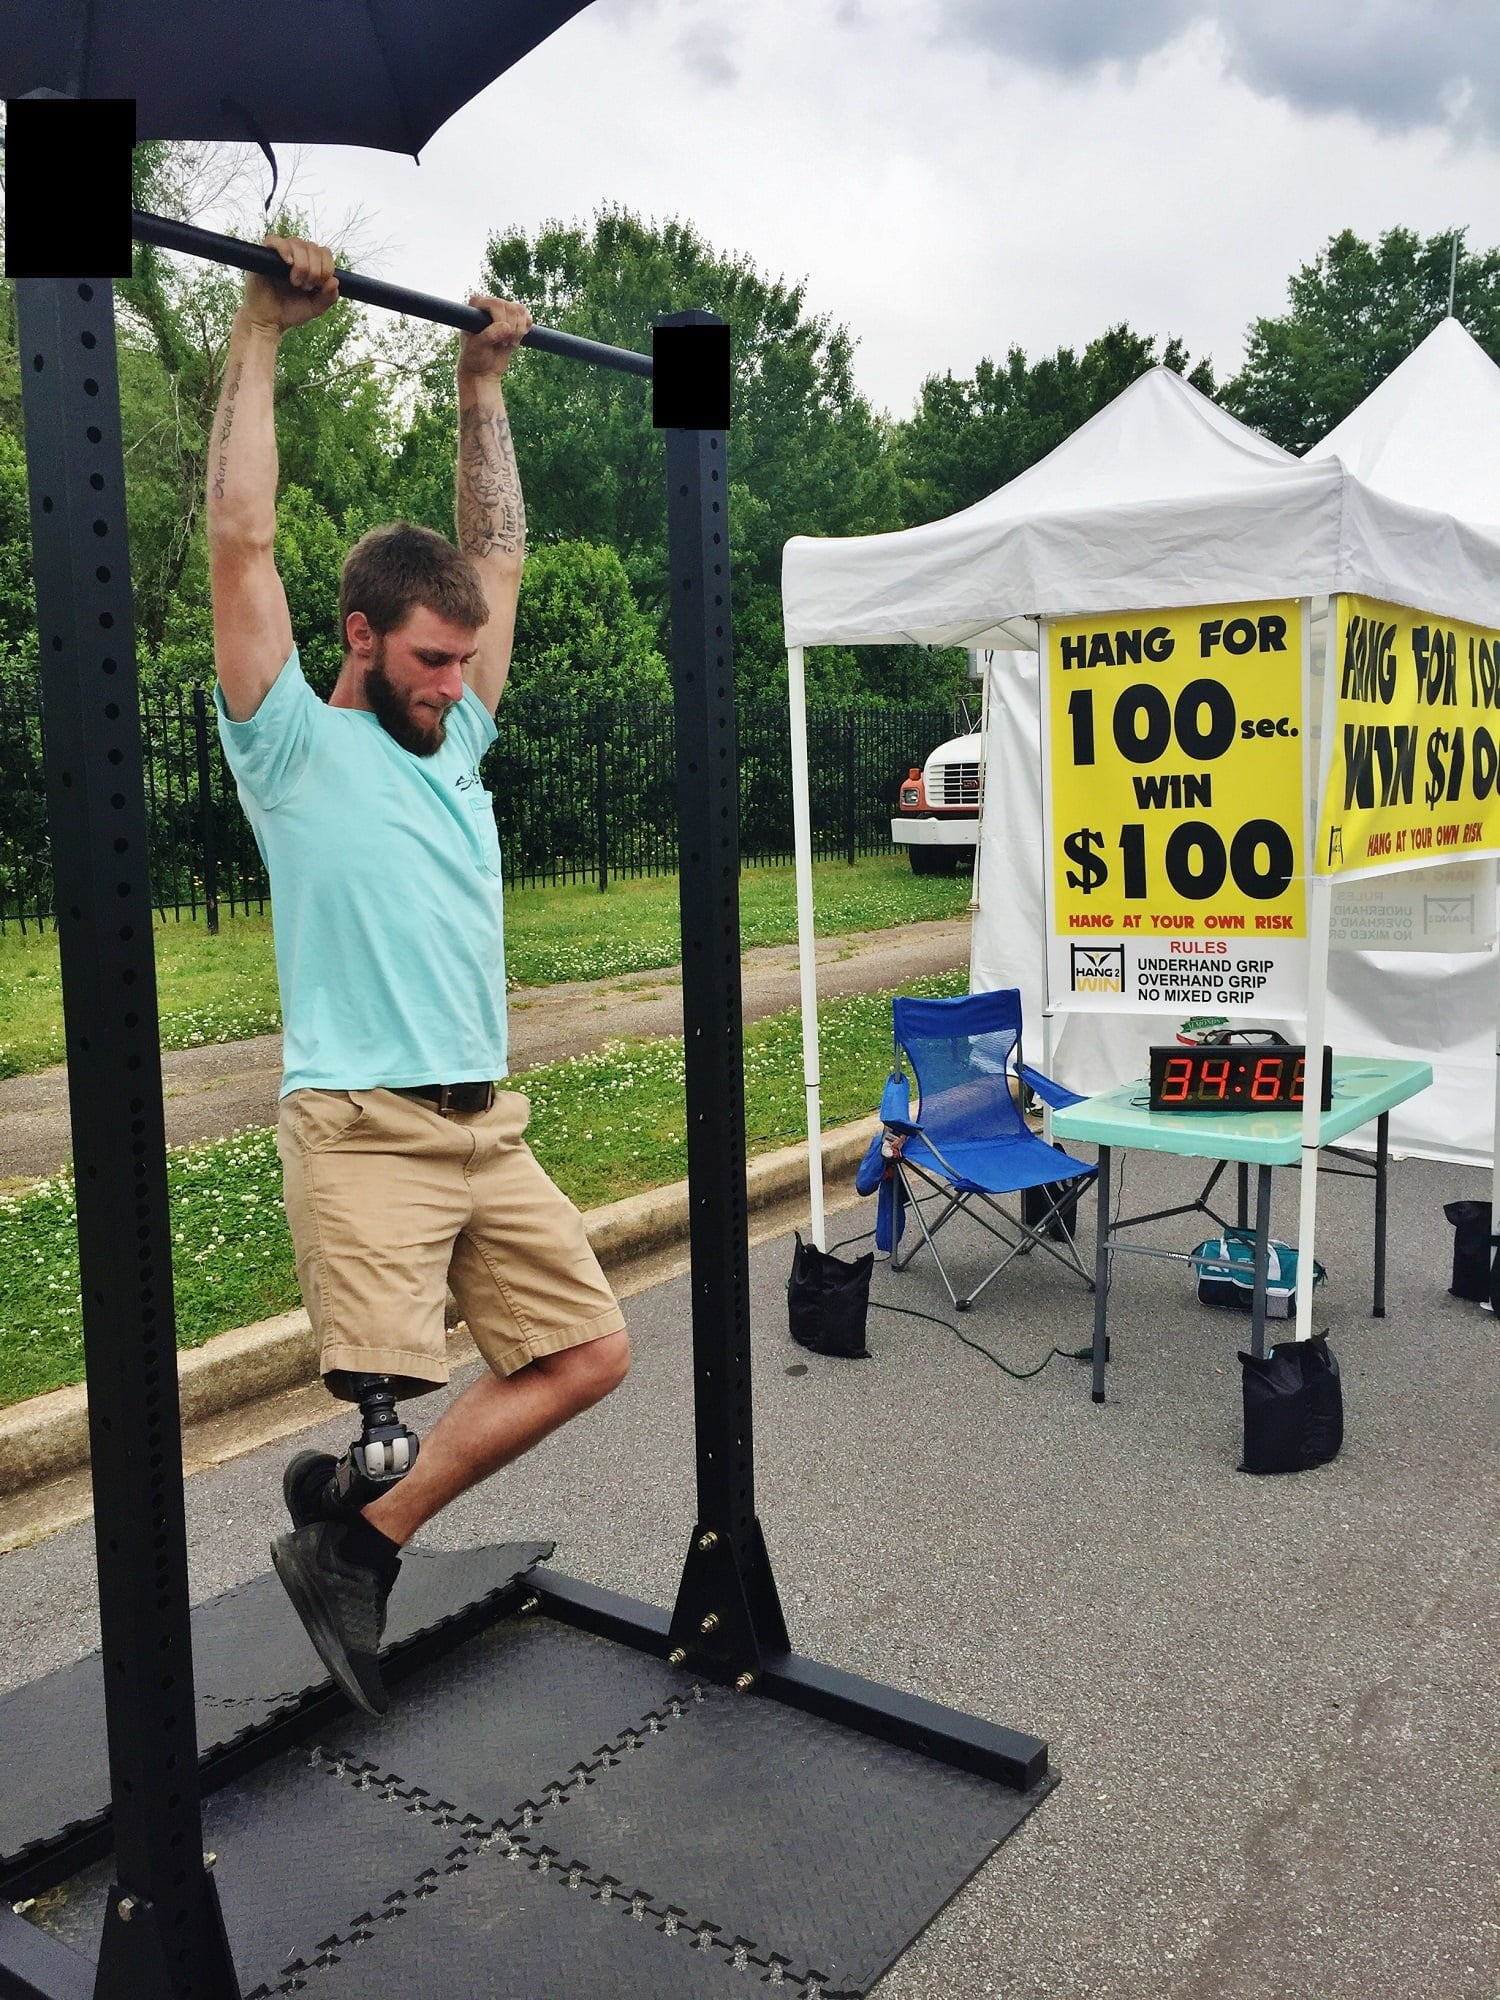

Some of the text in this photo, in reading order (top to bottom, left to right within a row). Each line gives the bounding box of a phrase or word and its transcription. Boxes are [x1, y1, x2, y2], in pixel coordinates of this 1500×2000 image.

[1060, 616, 1287, 670] HANG FOR
[1341, 616, 1397, 705] HANG
[1412, 625, 1457, 706] FOR
[1068, 678, 1299, 766] 100 sec.
[1344, 724, 1500, 811] WIN $10
[1132, 773, 1212, 810] WIN
[1367, 832, 1392, 857] HANG
[1396, 829, 1406, 852] AT
[1411, 827, 1432, 850] YOUR
[1437, 824, 1459, 846] OWN
[1463, 822, 1483, 844] RISK
[1064, 818, 1294, 900] $100
[1069, 915, 1294, 930] HANG AT YOUR OWN RISK
[1170, 941, 1228, 954] RULES
[1076, 968, 1113, 977] HANG
[1138, 958, 1274, 973] UNDERHAND GRIP
[1075, 976, 1119, 992] WIN
[1138, 974, 1267, 988] OVERHAND GRIP
[1138, 989, 1255, 1004] NO MIXED GRIP
